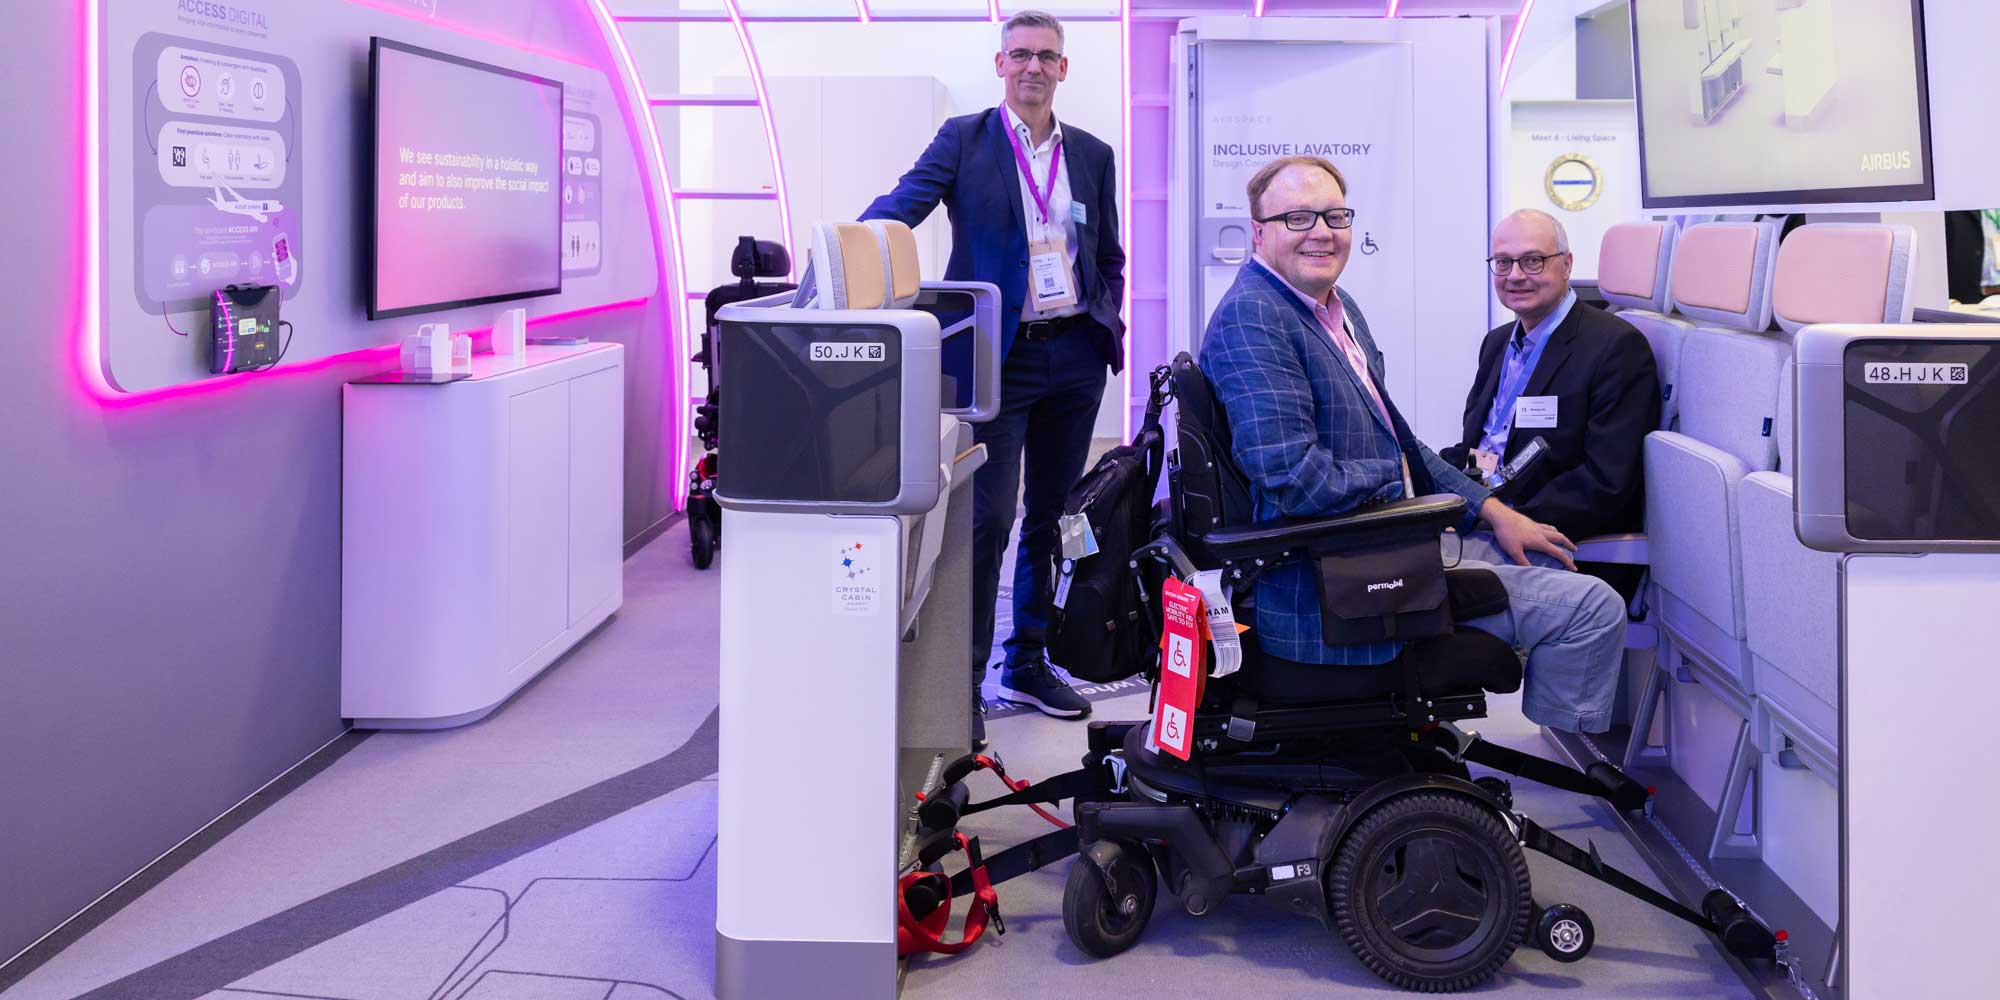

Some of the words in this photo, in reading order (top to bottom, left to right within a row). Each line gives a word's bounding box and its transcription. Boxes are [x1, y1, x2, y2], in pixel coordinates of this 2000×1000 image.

[177, 0, 227, 20] ACCESS
[229, 7, 269, 30] DIGITAL
[1531, 133, 1553, 142] Meet
[1566, 133, 1591, 143] Living
[1592, 133, 1617, 143] Space
[1213, 143, 1291, 156] INCLUSIVE
[1295, 143, 1372, 156] LAVATORY
[399, 147, 414, 164] We
[416, 151, 433, 165] see
[434, 151, 485, 171] sustainability
[486, 154, 493, 168] in
[494, 158, 499, 170] a
[499, 157, 524, 171] holistic
[525, 161, 539, 176] way
[1213, 159, 1243, 170] Design
[1859, 150, 1912, 172] AIRBUS
[399, 172, 416, 187] and
[418, 171, 435, 187] aim
[435, 174, 445, 187] to
[446, 174, 463, 189] also
[464, 175, 495, 192] improve
[495, 176, 507, 190] the
[507, 177, 528, 191] social
[528, 179, 549, 193] impact
[399, 193, 410, 209] of
[410, 196, 426, 210] our
[427, 195, 466, 212] products.
[1367, 578, 1403, 593] permobil
[1165, 605, 1186, 618] MOBILITY
[1168, 601, 1189, 614] ELECTRIC
[1206, 606, 1229, 617] HAM
[1166, 612, 1179, 623] SAFE
[1178, 617, 1186, 626] TO
[1296, 863, 1311, 877] F3
